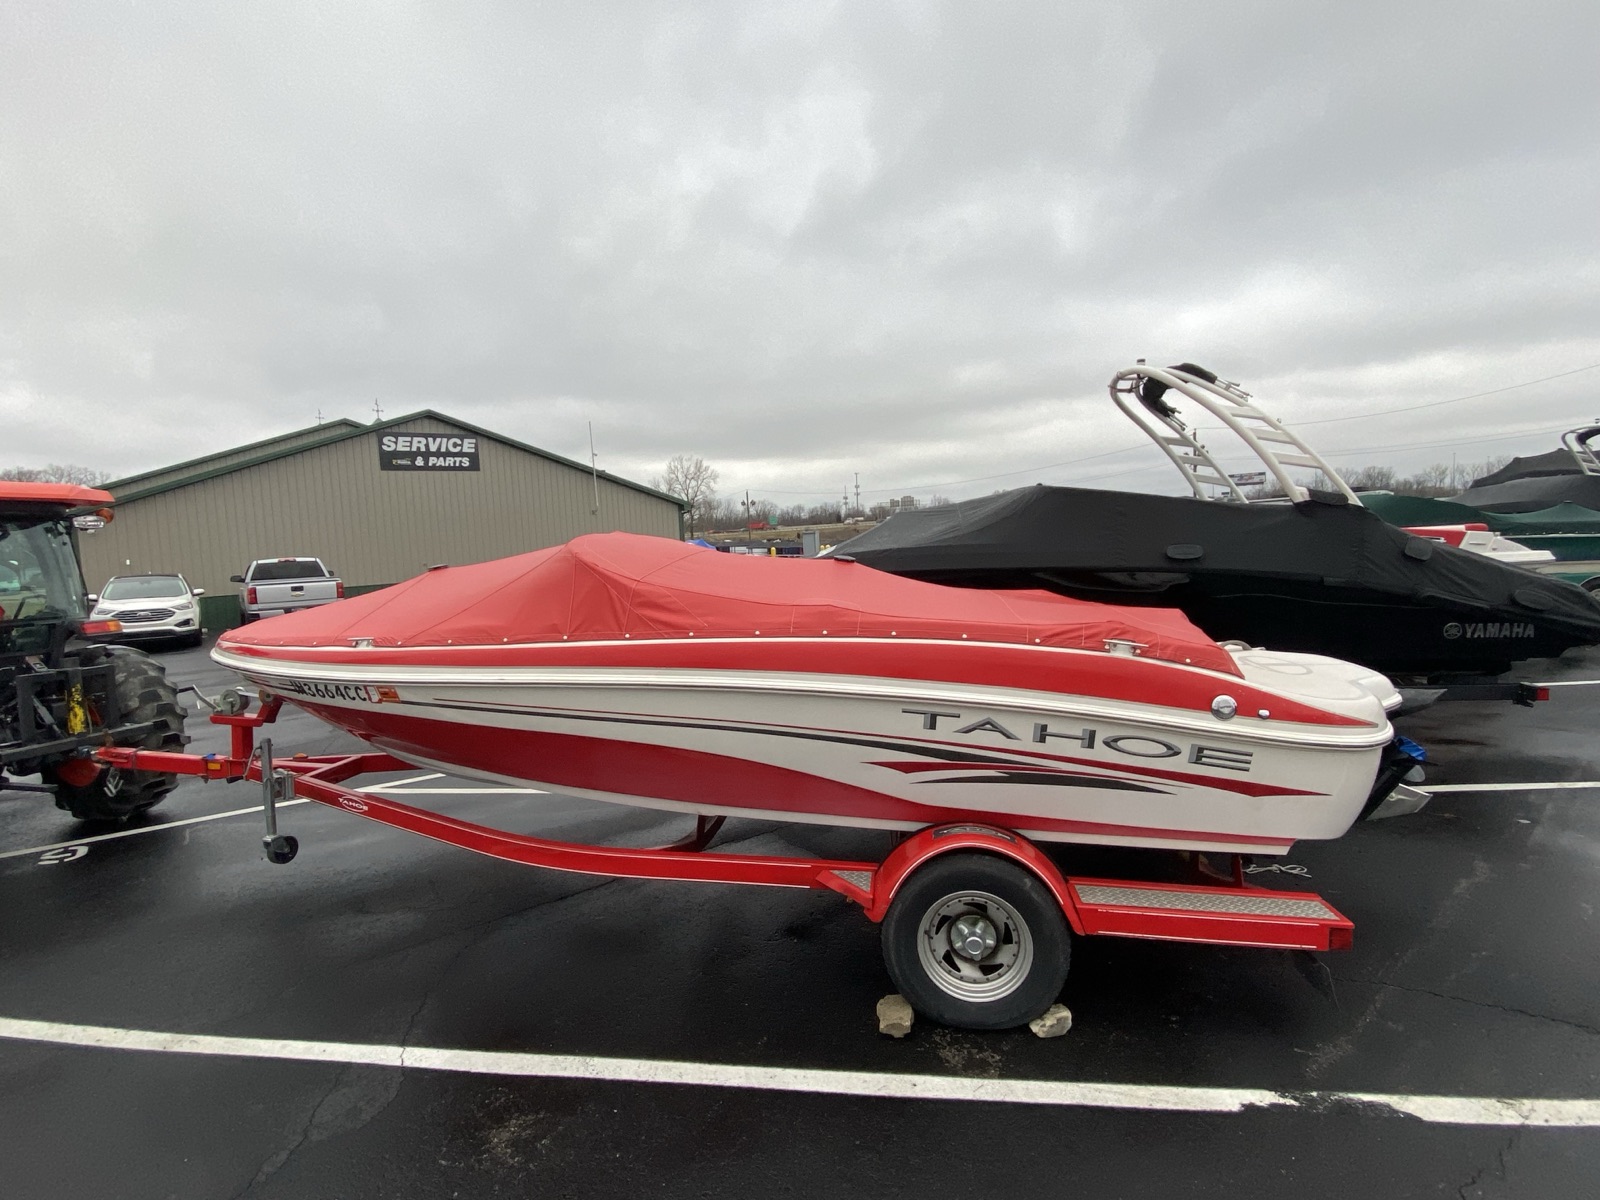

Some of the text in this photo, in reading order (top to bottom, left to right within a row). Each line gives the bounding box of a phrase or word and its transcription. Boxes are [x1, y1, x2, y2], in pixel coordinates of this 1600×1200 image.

[381, 435, 476, 453] SERVICE
[414, 456, 425, 467] &
[428, 456, 470, 467] PARTS
[1464, 622, 1535, 638] YAMAHA
[901, 707, 1254, 773] TAHOE
[337, 797, 369, 811] TAHOE
